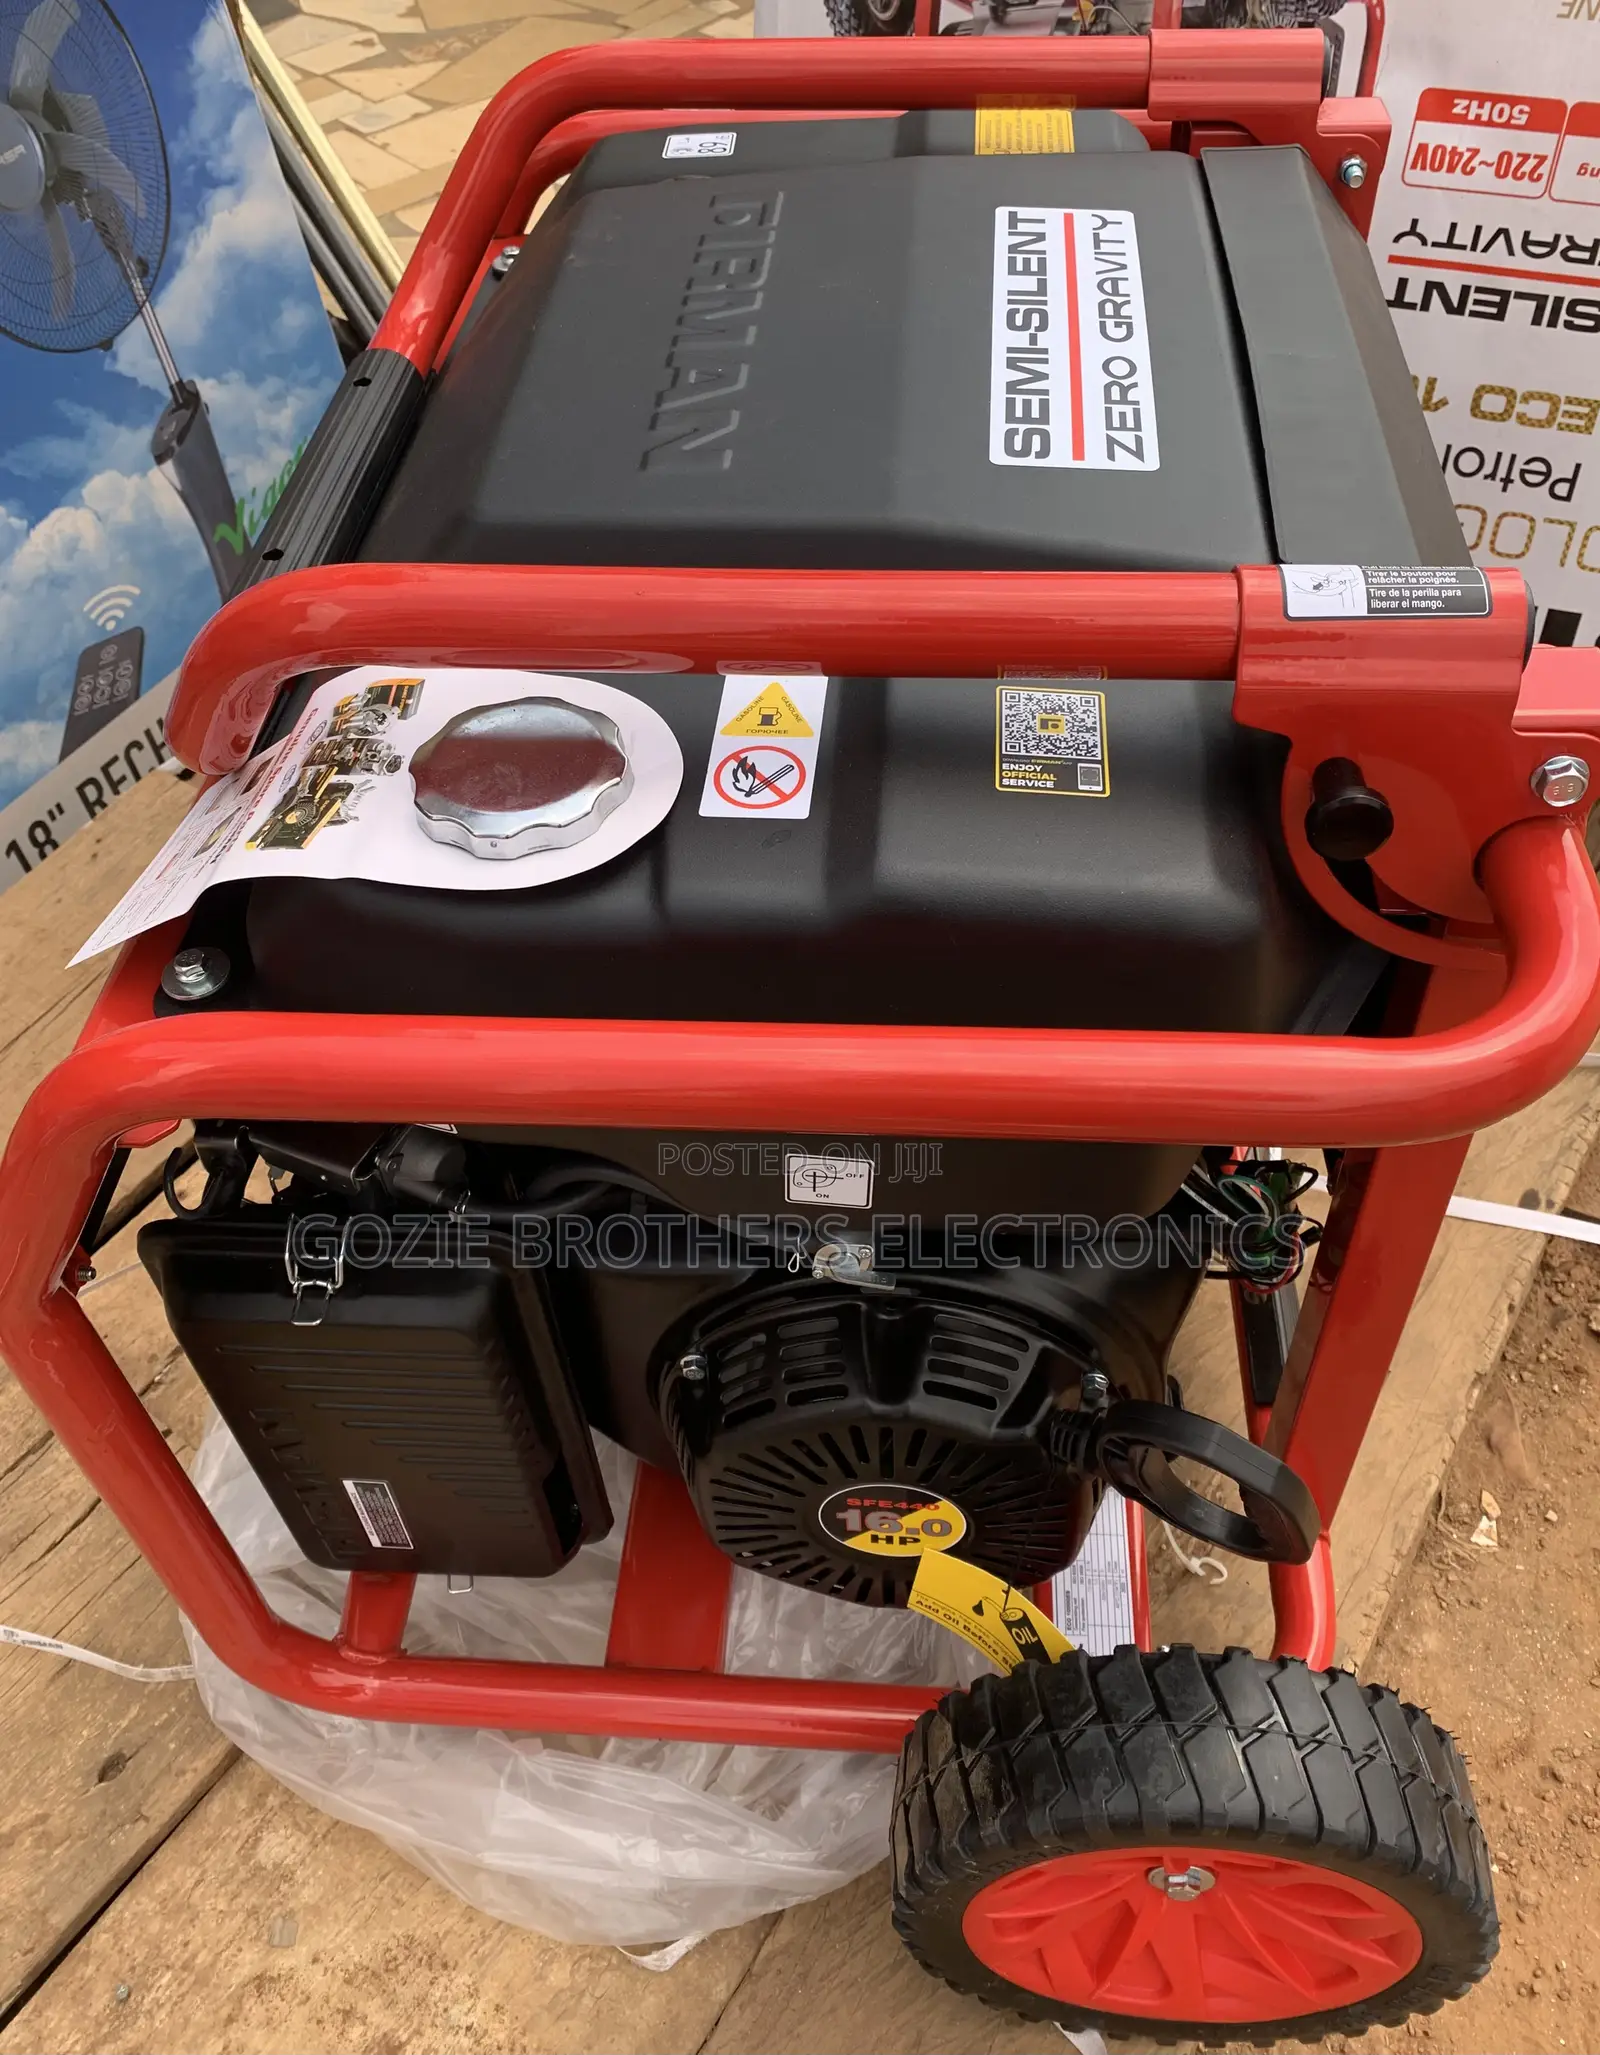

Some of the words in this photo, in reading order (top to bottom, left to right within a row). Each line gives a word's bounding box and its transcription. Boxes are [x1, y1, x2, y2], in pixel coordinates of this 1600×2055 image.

[1452, 98, 1531, 126] 50Hz
[1410, 142, 1548, 184] 220~240V
[1392, 218, 1600, 266] RAVITY
[1091, 213, 1134, 343] GRAVITY
[1004, 210, 1051, 460] SEMI-SILENT
[1411, 375, 1449, 413] 1
[1101, 356, 1145, 464] ZERO
[1470, 383, 1600, 436] ECO
[1441, 444, 1582, 503] Petrol
[1369, 588, 1387, 597] Tire
[1388, 588, 1400, 597] de
[1402, 588, 1411, 597] la
[1412, 588, 1440, 599] perilla
[1441, 589, 1462, 599] para
[1408, 576, 1417, 584] la
[1370, 599, 1400, 609] liberar
[1401, 599, 1410, 609] el
[1411, 600, 1445, 610] mango.
[735, 695, 764, 723] GASOLINE
[781, 695, 803, 724] GASOLINE
[1002, 763, 1043, 772] ENJOY
[1002, 771, 1057, 781] OFFICIAL
[1002, 778, 1055, 788] SERVICE
[846, 1498, 940, 1511] SFE440
[836, 1508, 952, 1537] 16.0
[870, 1534, 921, 1546] HP
[915, 1600, 939, 1614] Add
[943, 1613, 959, 1626] Oil
[963, 1624, 999, 1656] Before
[1011, 1626, 1039, 1645] OIL
